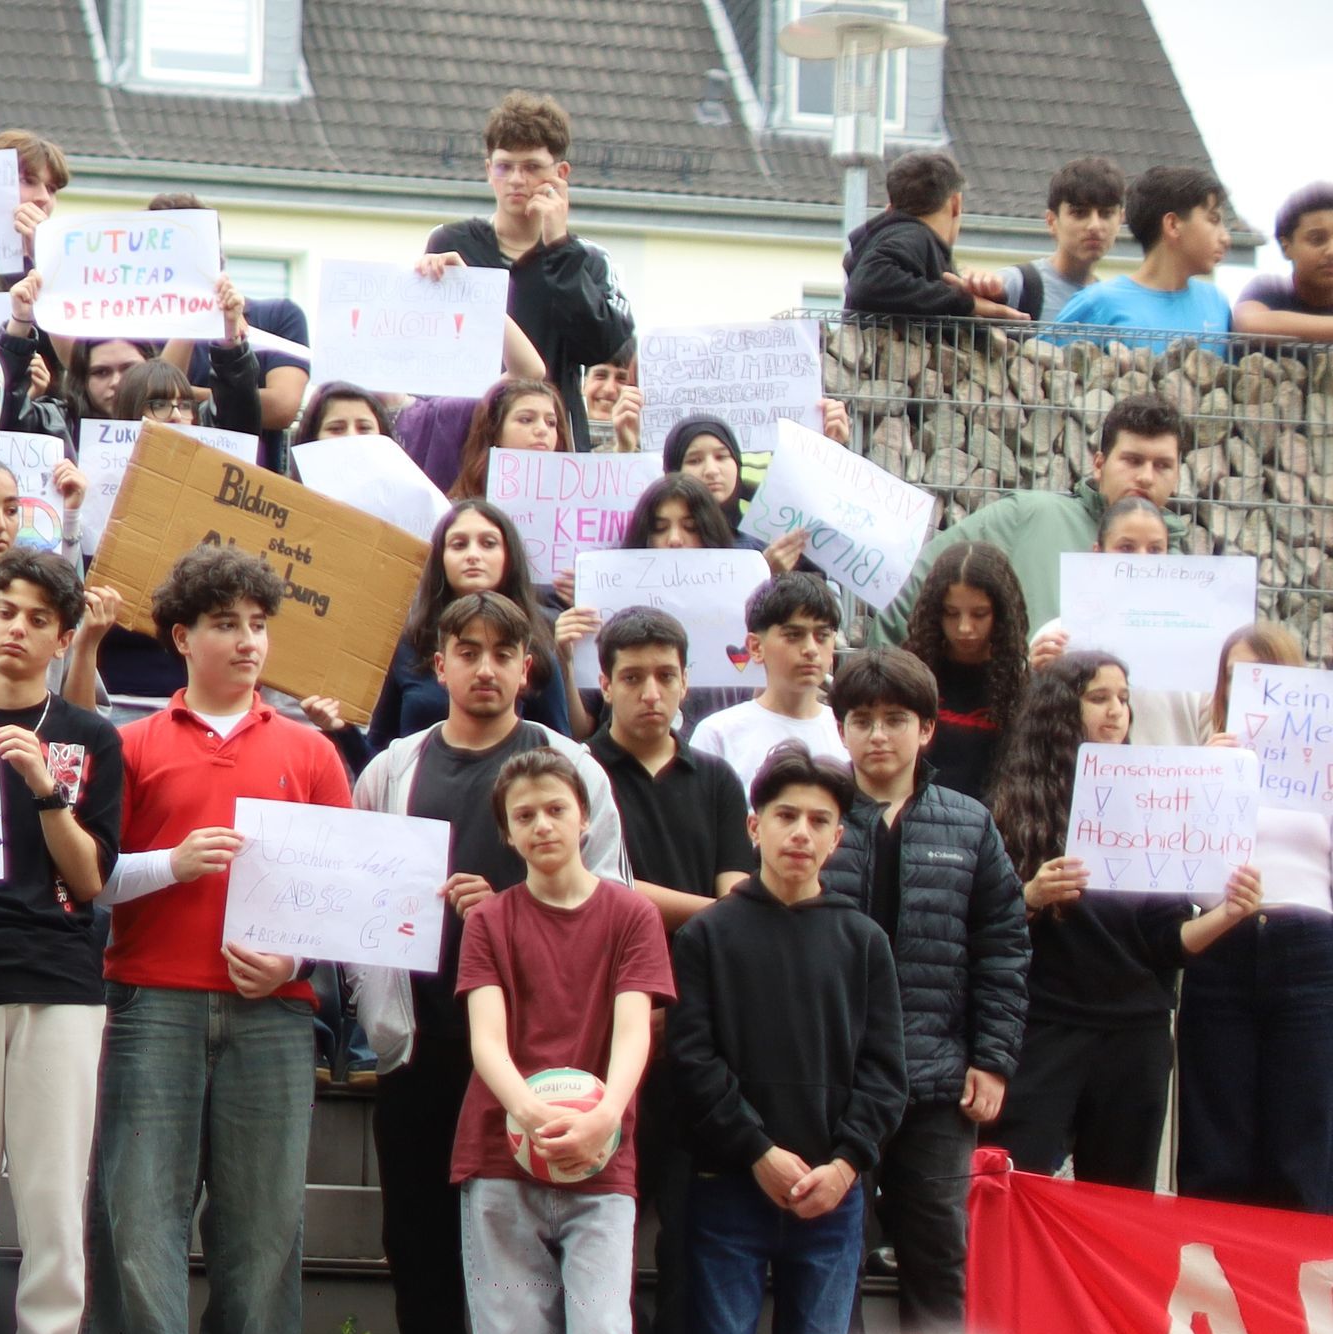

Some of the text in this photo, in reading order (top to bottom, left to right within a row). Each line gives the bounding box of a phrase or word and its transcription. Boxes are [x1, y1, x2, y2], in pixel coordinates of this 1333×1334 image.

[64, 227, 174, 256] FUTURE
[83, 264, 174, 285] INSTEAD
[496, 453, 646, 500] BILDUNG
[213, 461, 290, 530] Bildung
[554, 506, 637, 543] KEIN
[268, 536, 313, 565] statt
[635, 556, 736, 590] Zukunft
[1114, 562, 1217, 588] Abschiebung
[1263, 678, 1330, 709] Kein
[1083, 753, 1224, 777] Menschenrechte
[1263, 739, 1287, 761] ist
[1259, 763, 1319, 799] legal
[1136, 786, 1196, 813] statt
[1077, 819, 1253, 867] Abschiebung
